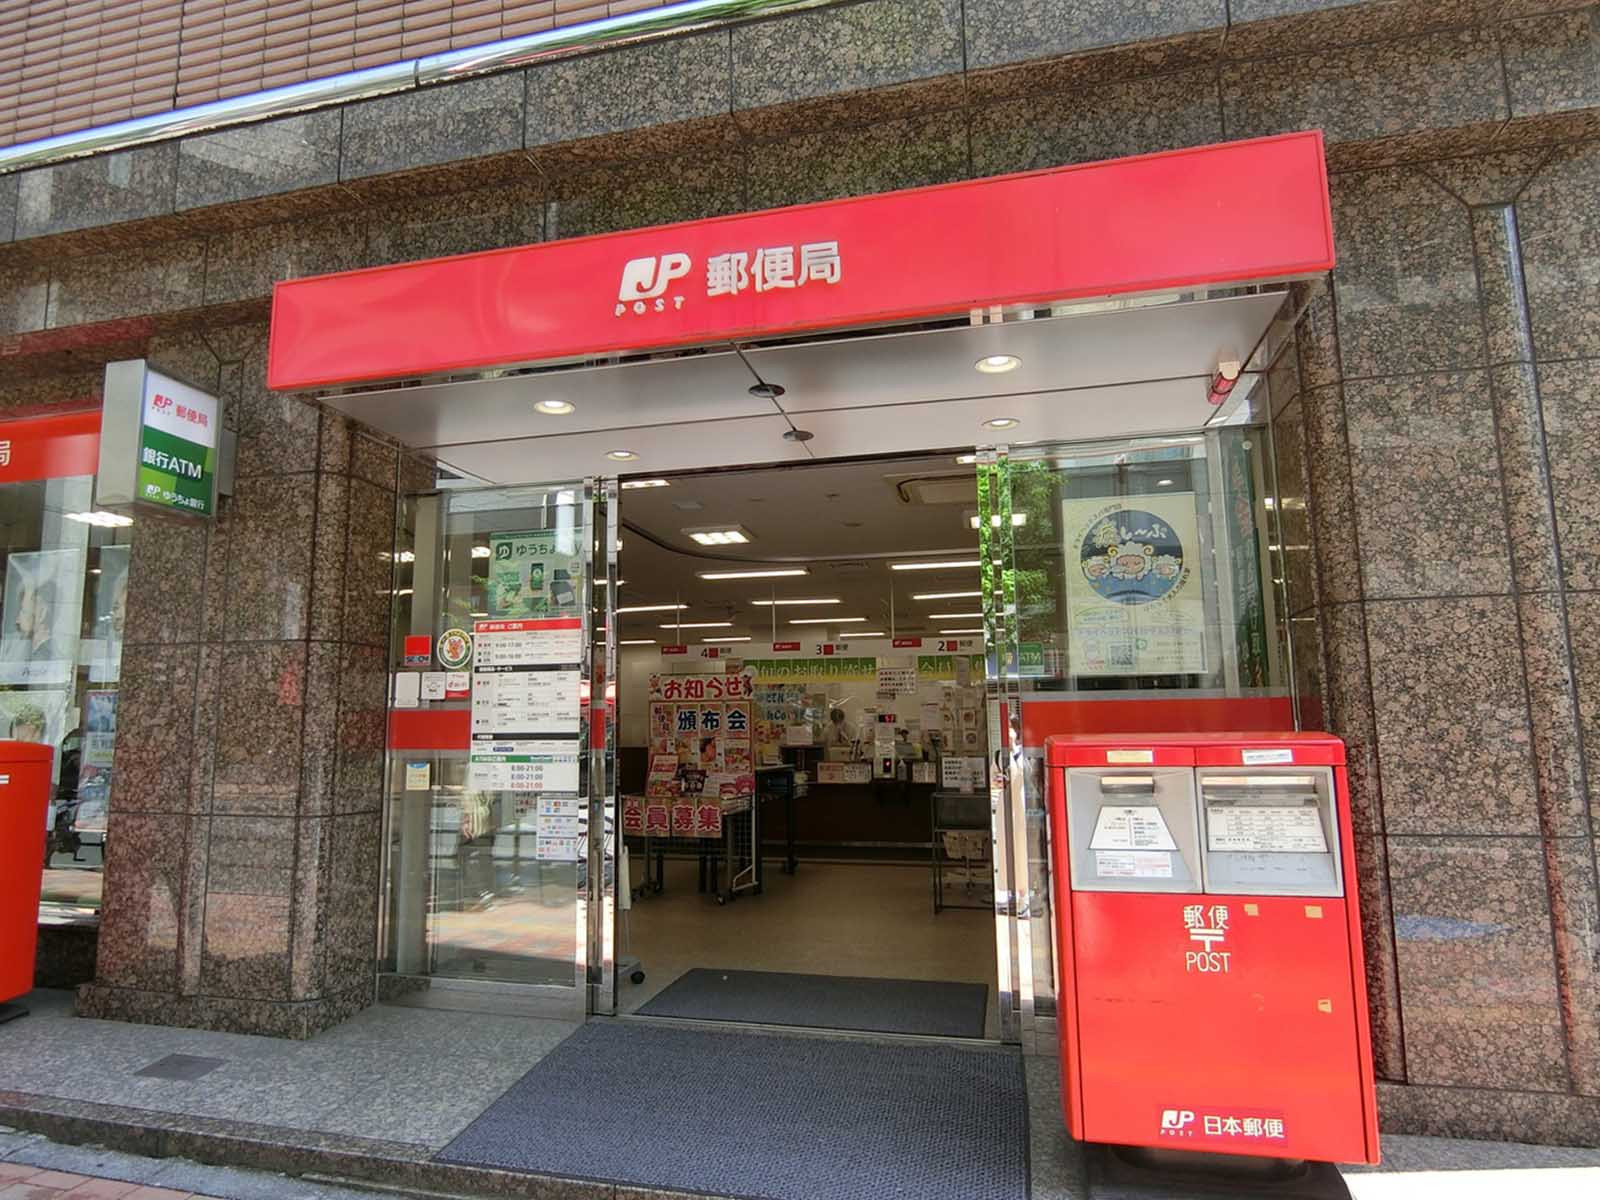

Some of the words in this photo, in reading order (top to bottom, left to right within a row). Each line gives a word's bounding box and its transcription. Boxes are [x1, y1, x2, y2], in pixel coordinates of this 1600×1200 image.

[706, 240, 842, 297] 郵便局
[615, 295, 685, 318] POST
[175, 404, 209, 428] 郵便局
[0, 439, 11, 467] 局
[142, 446, 203, 479] 銀行ATM
[162, 490, 206, 511] ゆうちょ銀行
[701, 648, 708, 658] 4
[816, 644, 822, 655] 3
[938, 641, 945, 651] 2
[663, 676, 742, 700] お知らせ
[677, 709, 748, 731] 頒布会
[624, 805, 720, 831] 会員募集
[1183, 905, 1230, 929] 郵便
[1185, 952, 1231, 973] POST
[1203, 1115, 1285, 1139] 日本郵便
